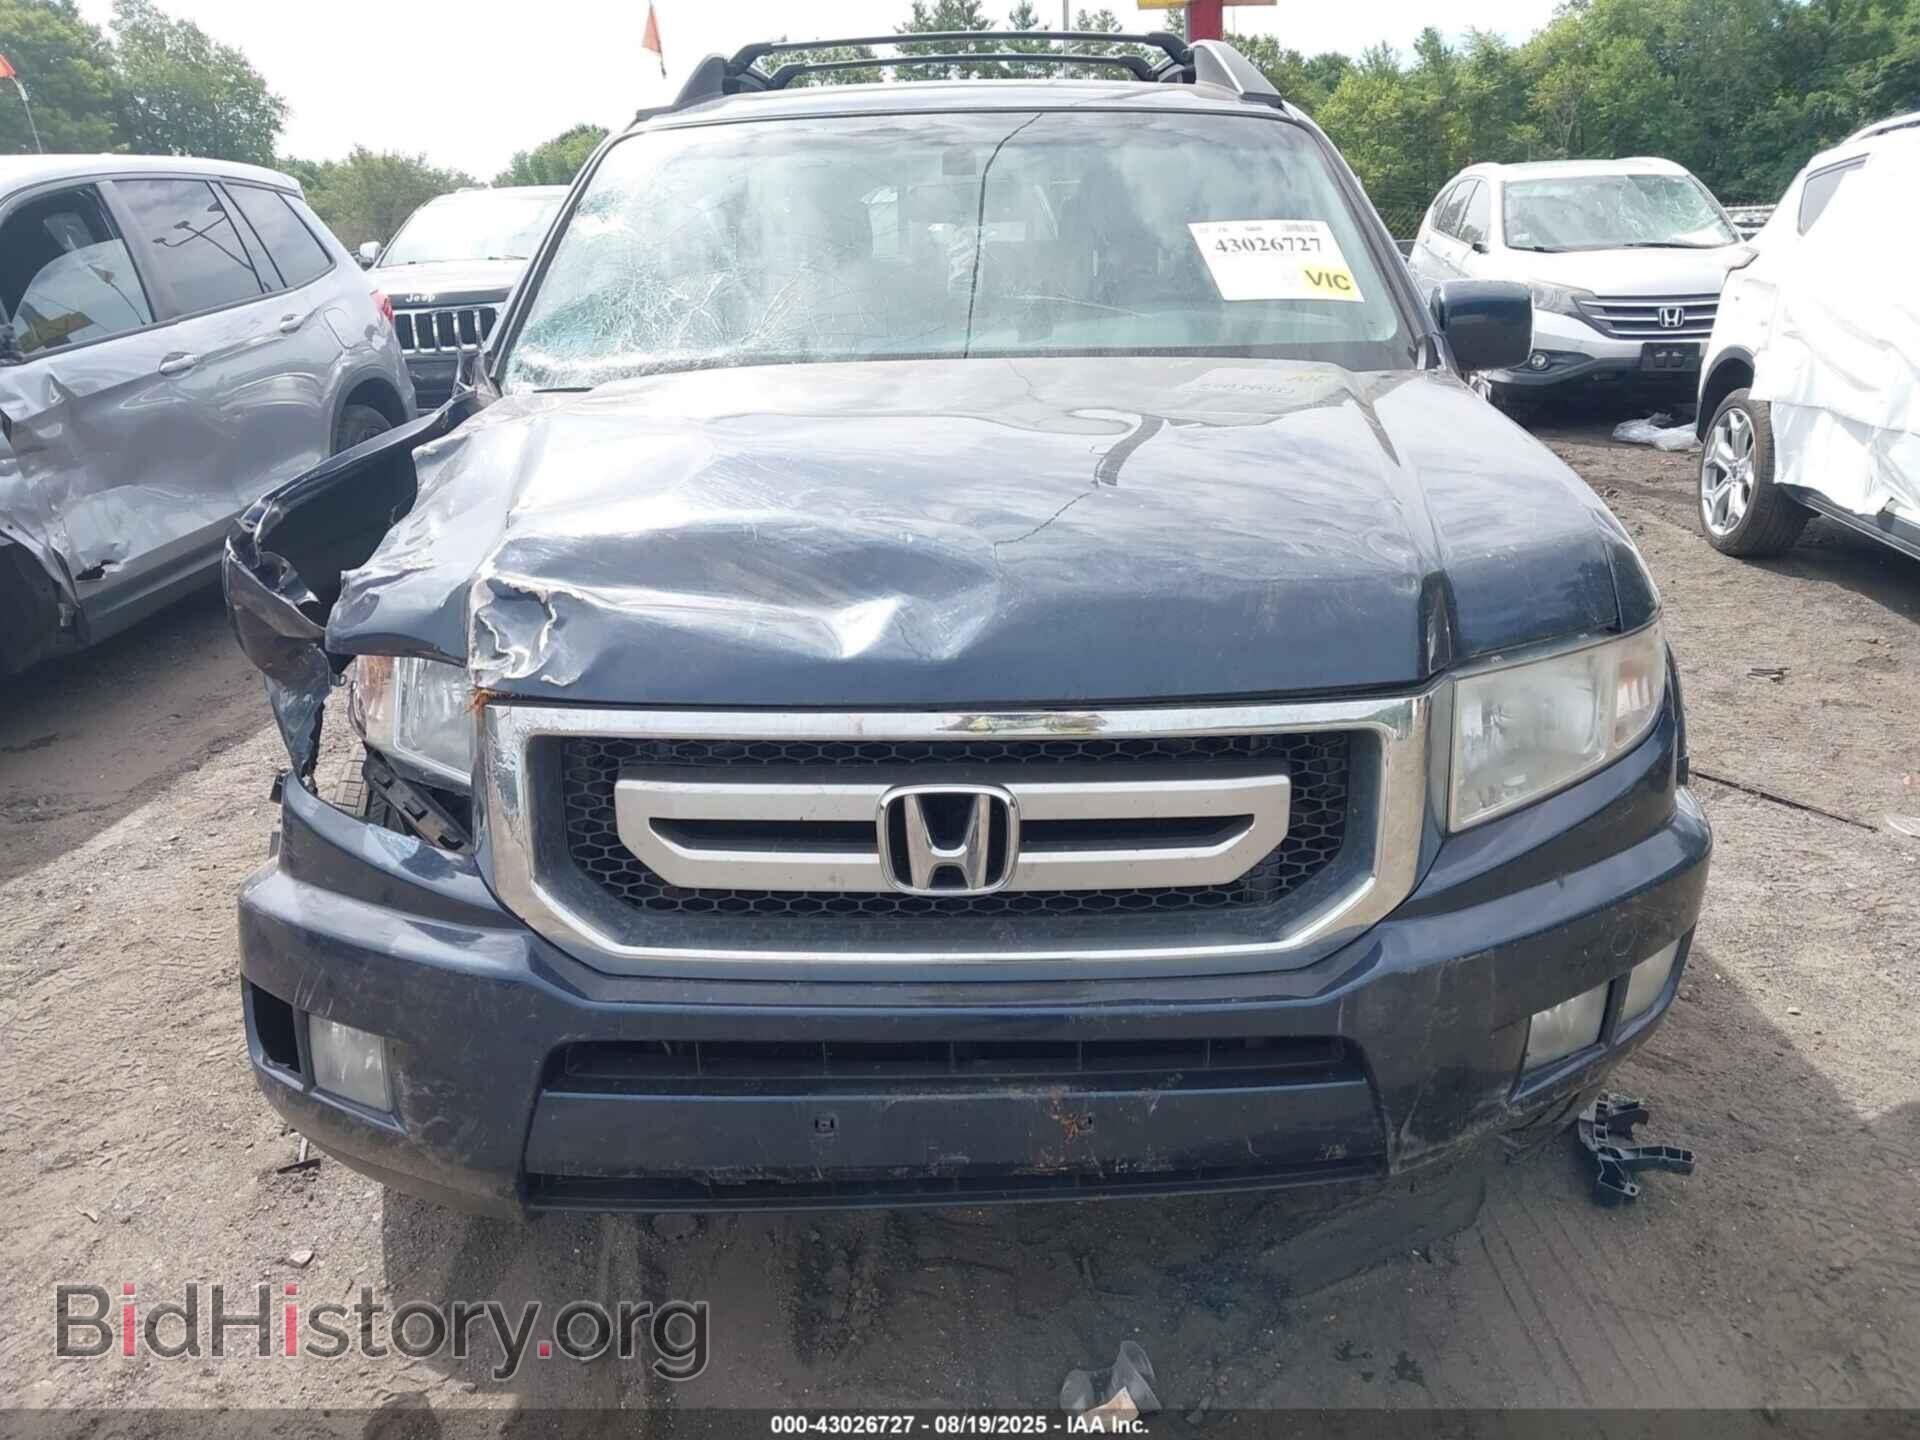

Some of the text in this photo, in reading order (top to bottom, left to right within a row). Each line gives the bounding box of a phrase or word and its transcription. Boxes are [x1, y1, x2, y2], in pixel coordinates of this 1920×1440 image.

[1215, 237, 1321, 253] 43026727
[1304, 269, 1351, 290] VIC
[405, 293, 436, 303] Jeep
